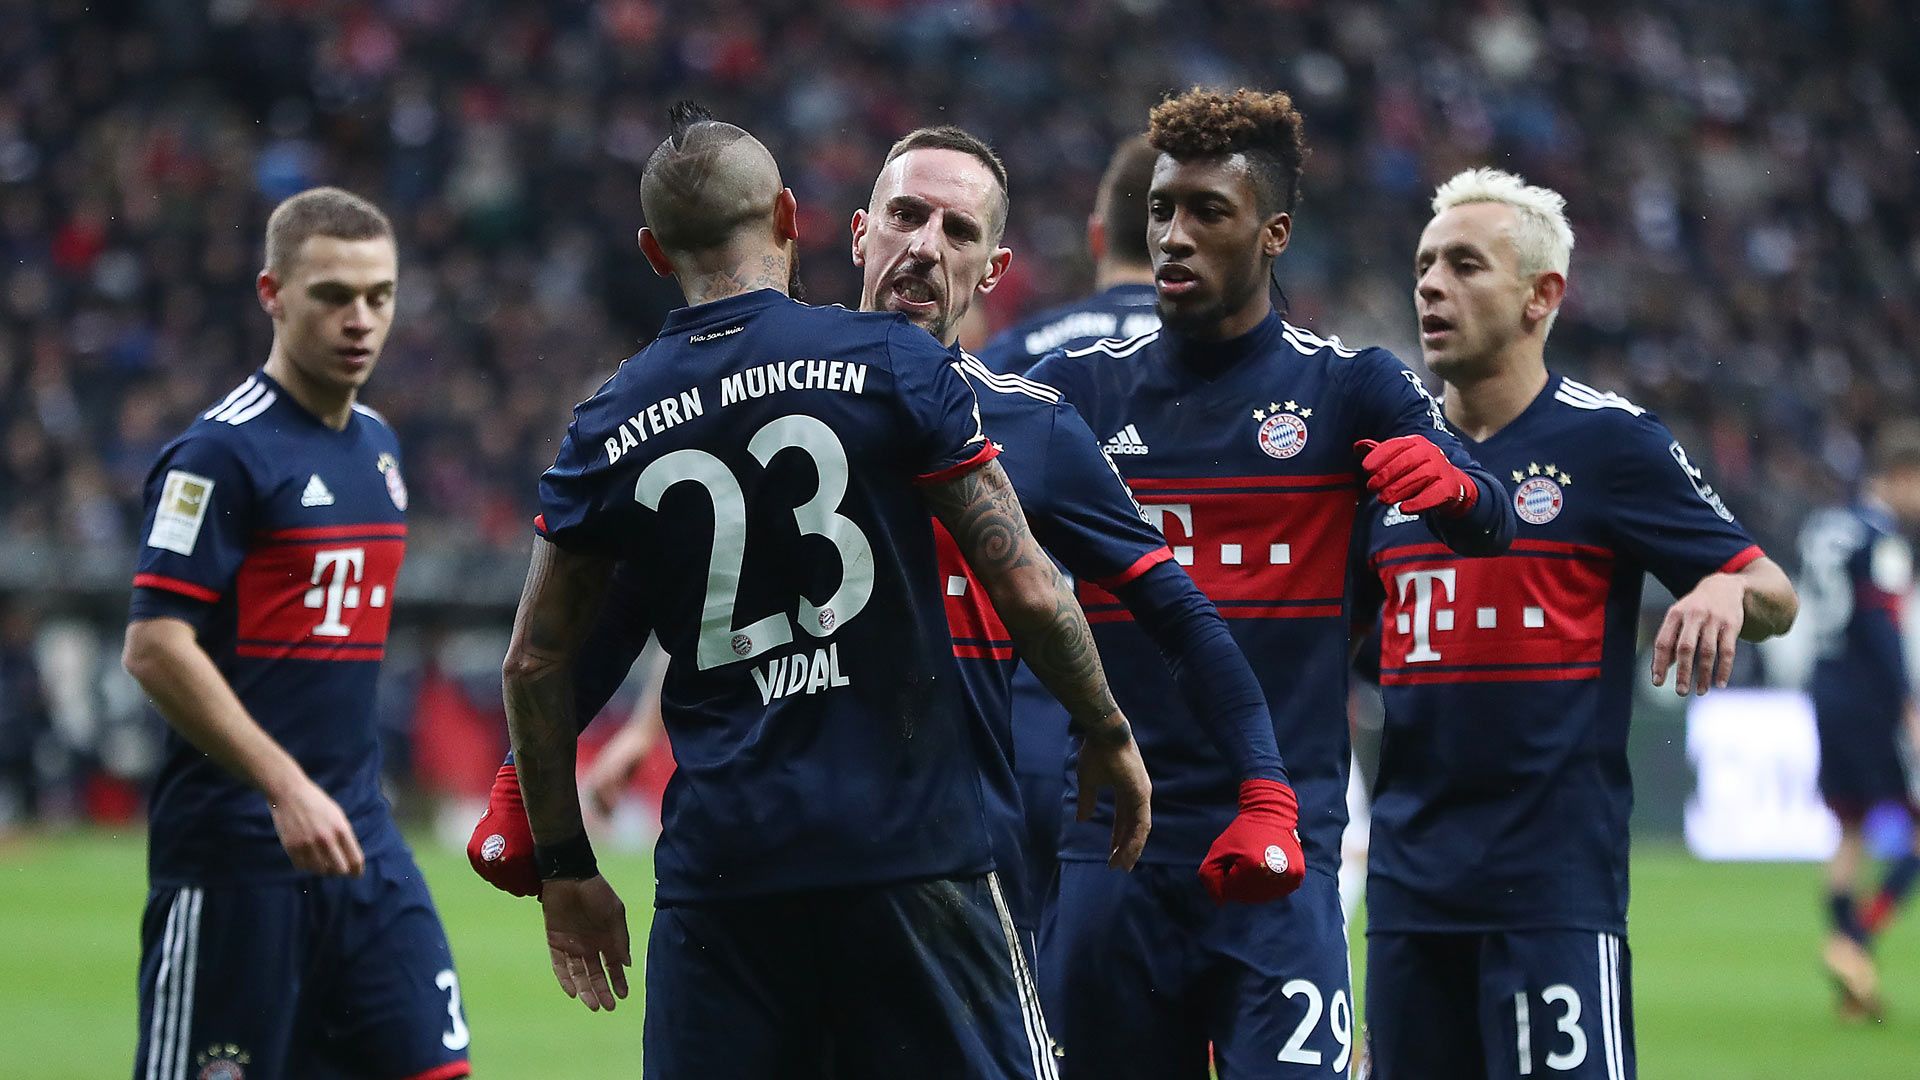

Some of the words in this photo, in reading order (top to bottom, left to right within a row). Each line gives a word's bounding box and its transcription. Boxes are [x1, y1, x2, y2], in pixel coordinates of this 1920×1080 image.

[604, 387, 704, 466] BAYERN
[721, 360, 867, 407] MÜNCHEN
[1103, 443, 1149, 455] adidas
[634, 414, 875, 671] 23
[751, 642, 850, 706] VIDAL
[435, 969, 470, 1051] 3
[1277, 979, 1354, 1073] 29
[1515, 983, 1588, 1075] 13
